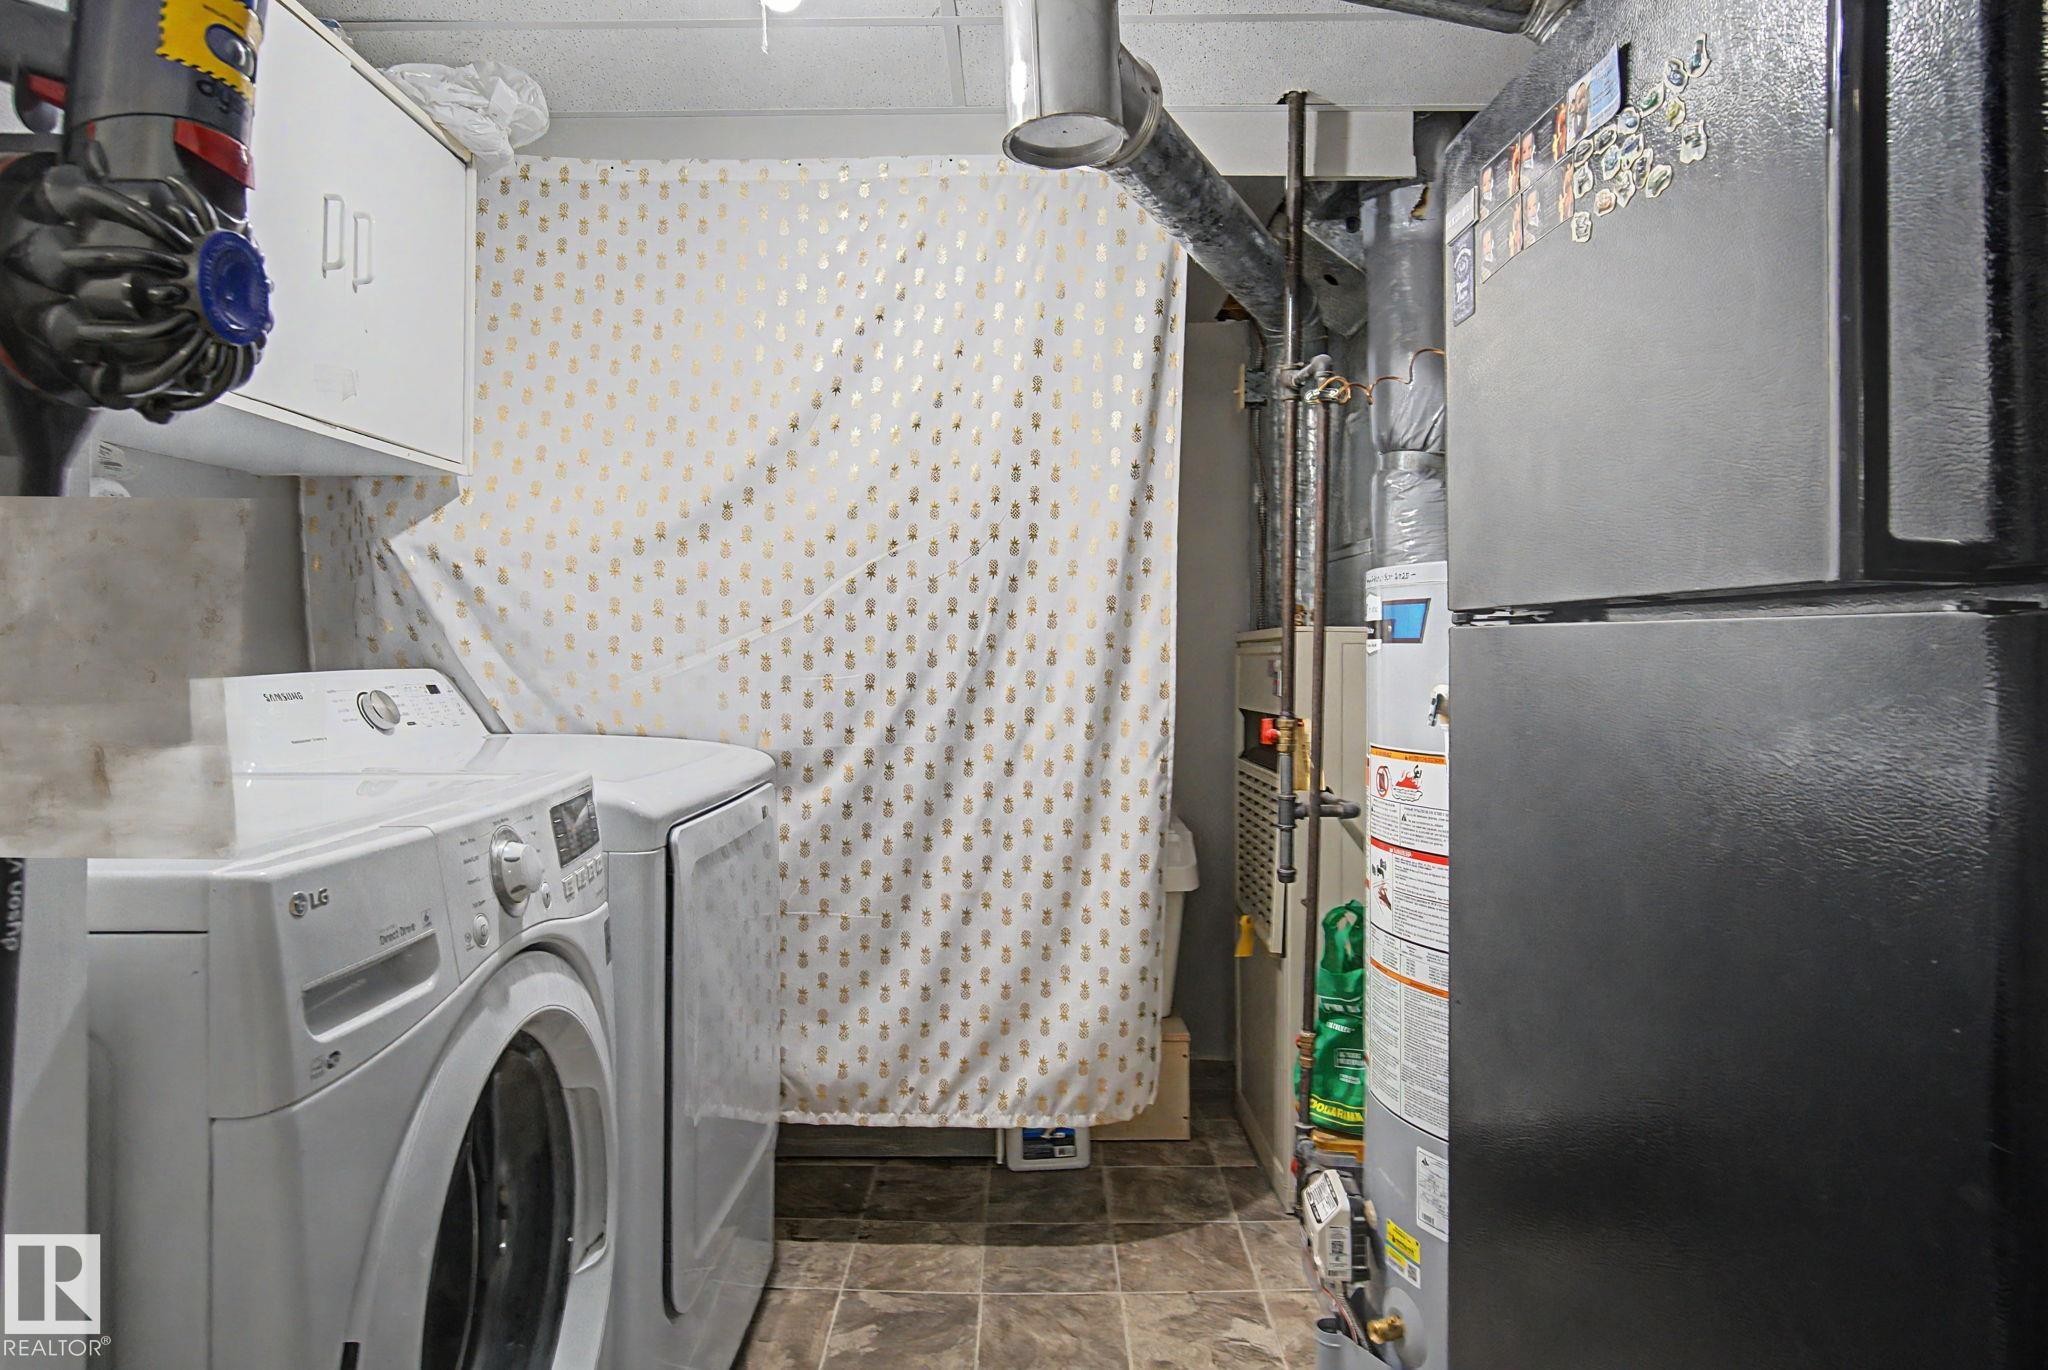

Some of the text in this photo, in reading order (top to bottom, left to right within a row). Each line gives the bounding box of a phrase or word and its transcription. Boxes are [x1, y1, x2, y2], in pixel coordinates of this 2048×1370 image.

[263, 691, 304, 703] SAMSUNG
[309, 888, 330, 910] LG
[0, 880, 23, 951] dyson
